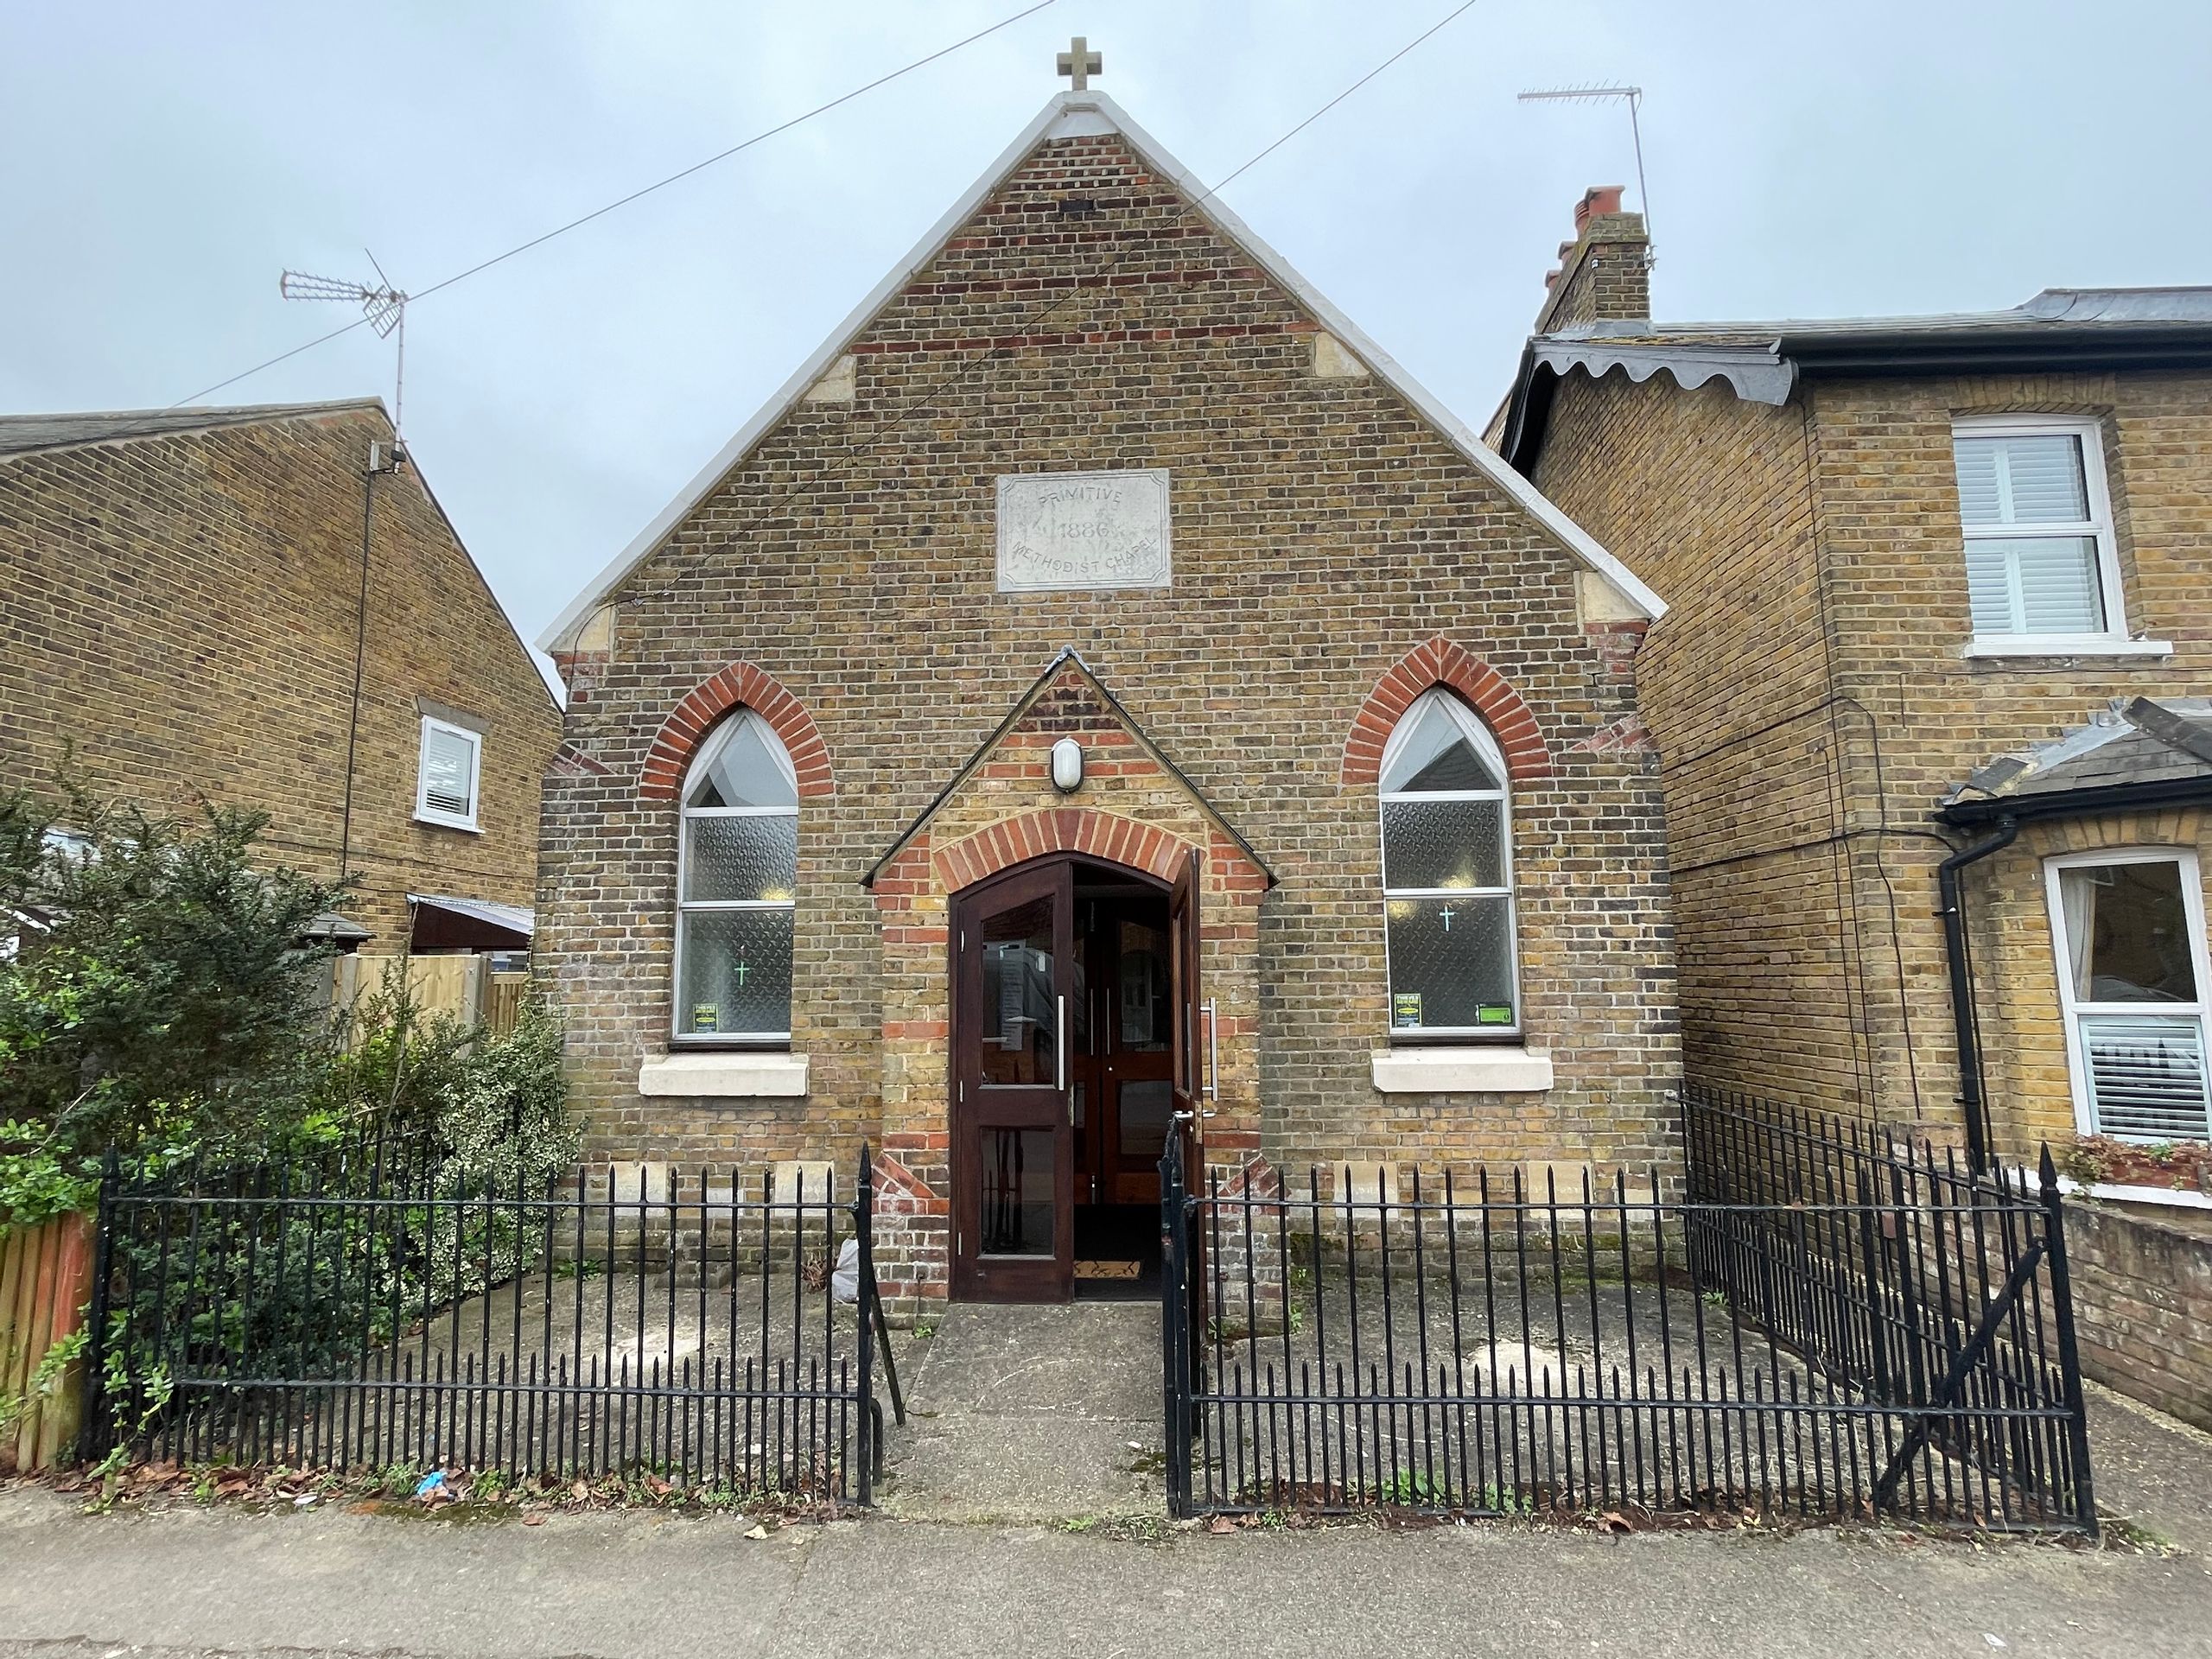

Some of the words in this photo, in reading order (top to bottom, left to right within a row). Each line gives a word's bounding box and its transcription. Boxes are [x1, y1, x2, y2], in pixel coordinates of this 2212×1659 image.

[1038, 486, 1122, 507] PRIMITIVE
[1059, 521, 1110, 538] 1886
[1012, 541, 1100, 574] METHODIST
[1105, 536, 1157, 569] CHAPEL
